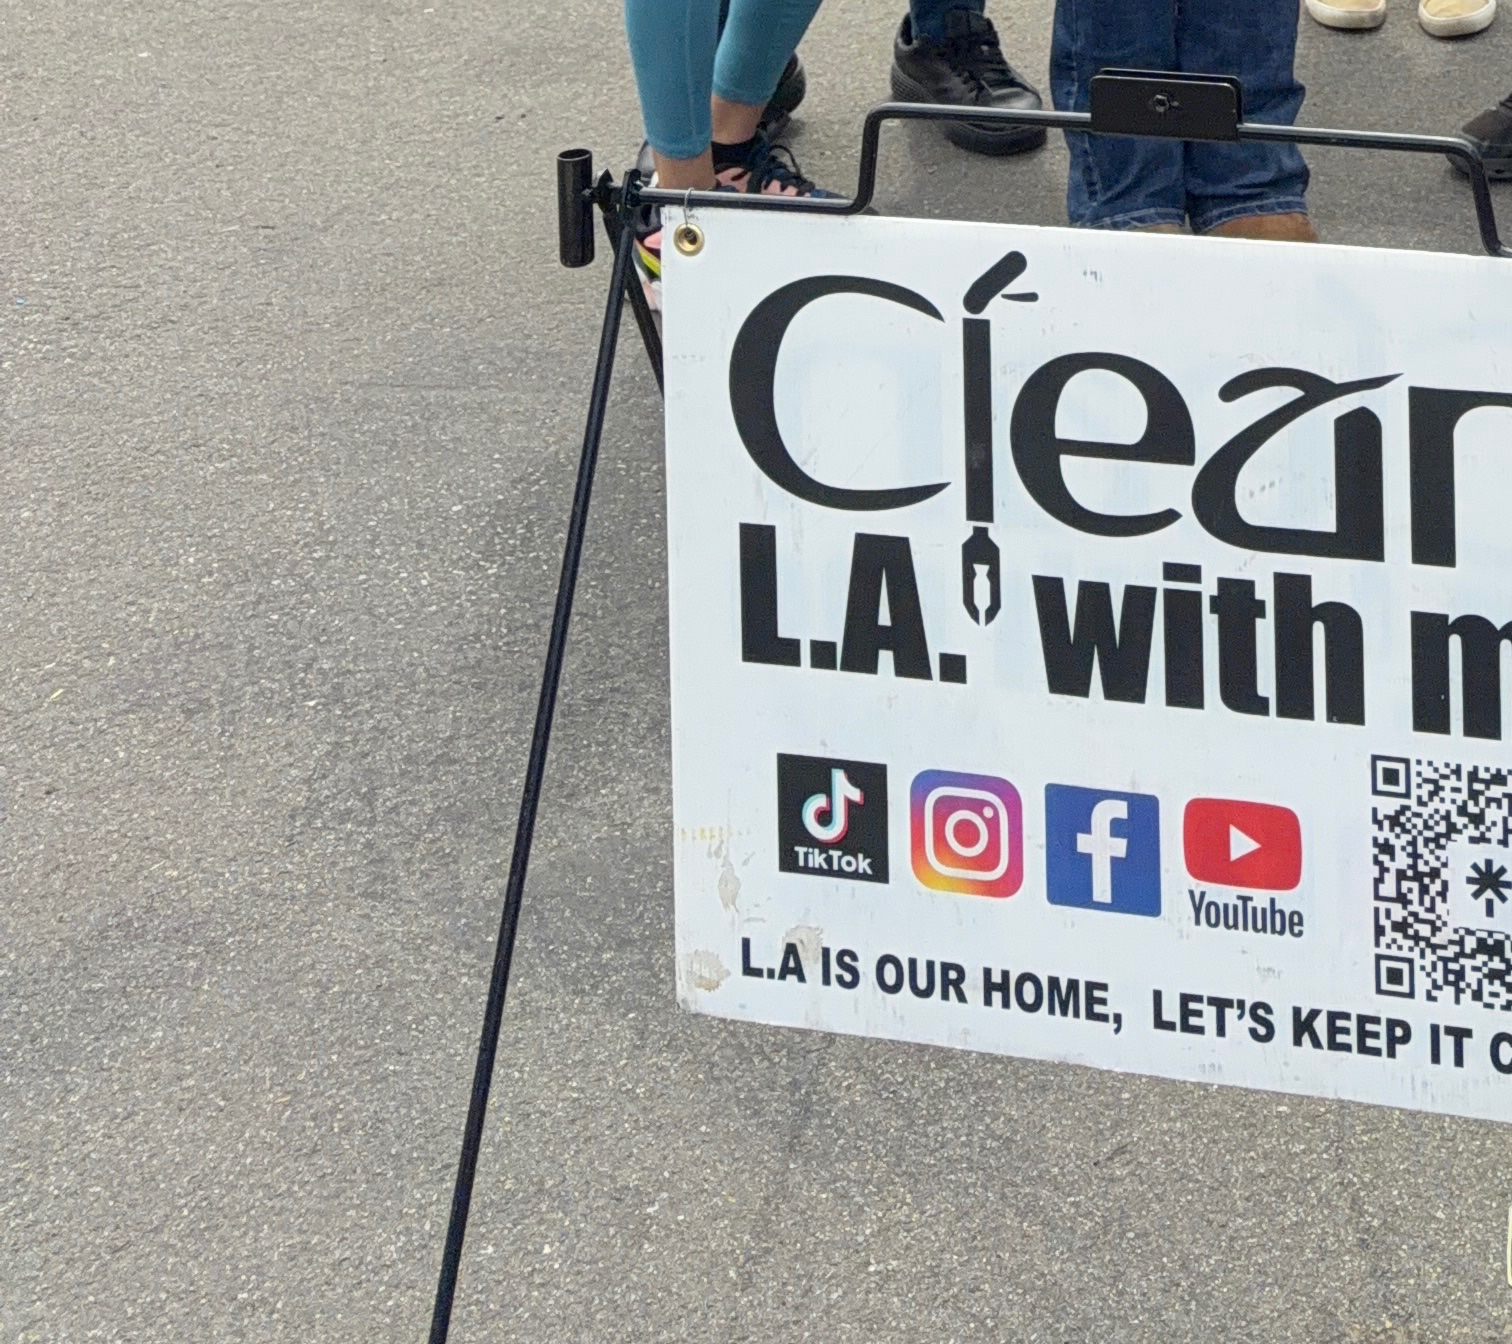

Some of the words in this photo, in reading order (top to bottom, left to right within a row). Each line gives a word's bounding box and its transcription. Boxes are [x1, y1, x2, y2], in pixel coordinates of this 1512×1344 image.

[739, 522, 967, 684] L.A.
[1032, 562, 1366, 726] with
[794, 846, 873, 876] TikTok
[1188, 889, 1304, 938] YouTube
[741, 937, 806, 983] L.A
[821, 947, 860, 990] IS
[875, 954, 968, 1004] OUR
[982, 966, 1122, 1035] HOME,
[1292, 1005, 1412, 1059] KEEP
[1430, 1023, 1473, 1068] IT
